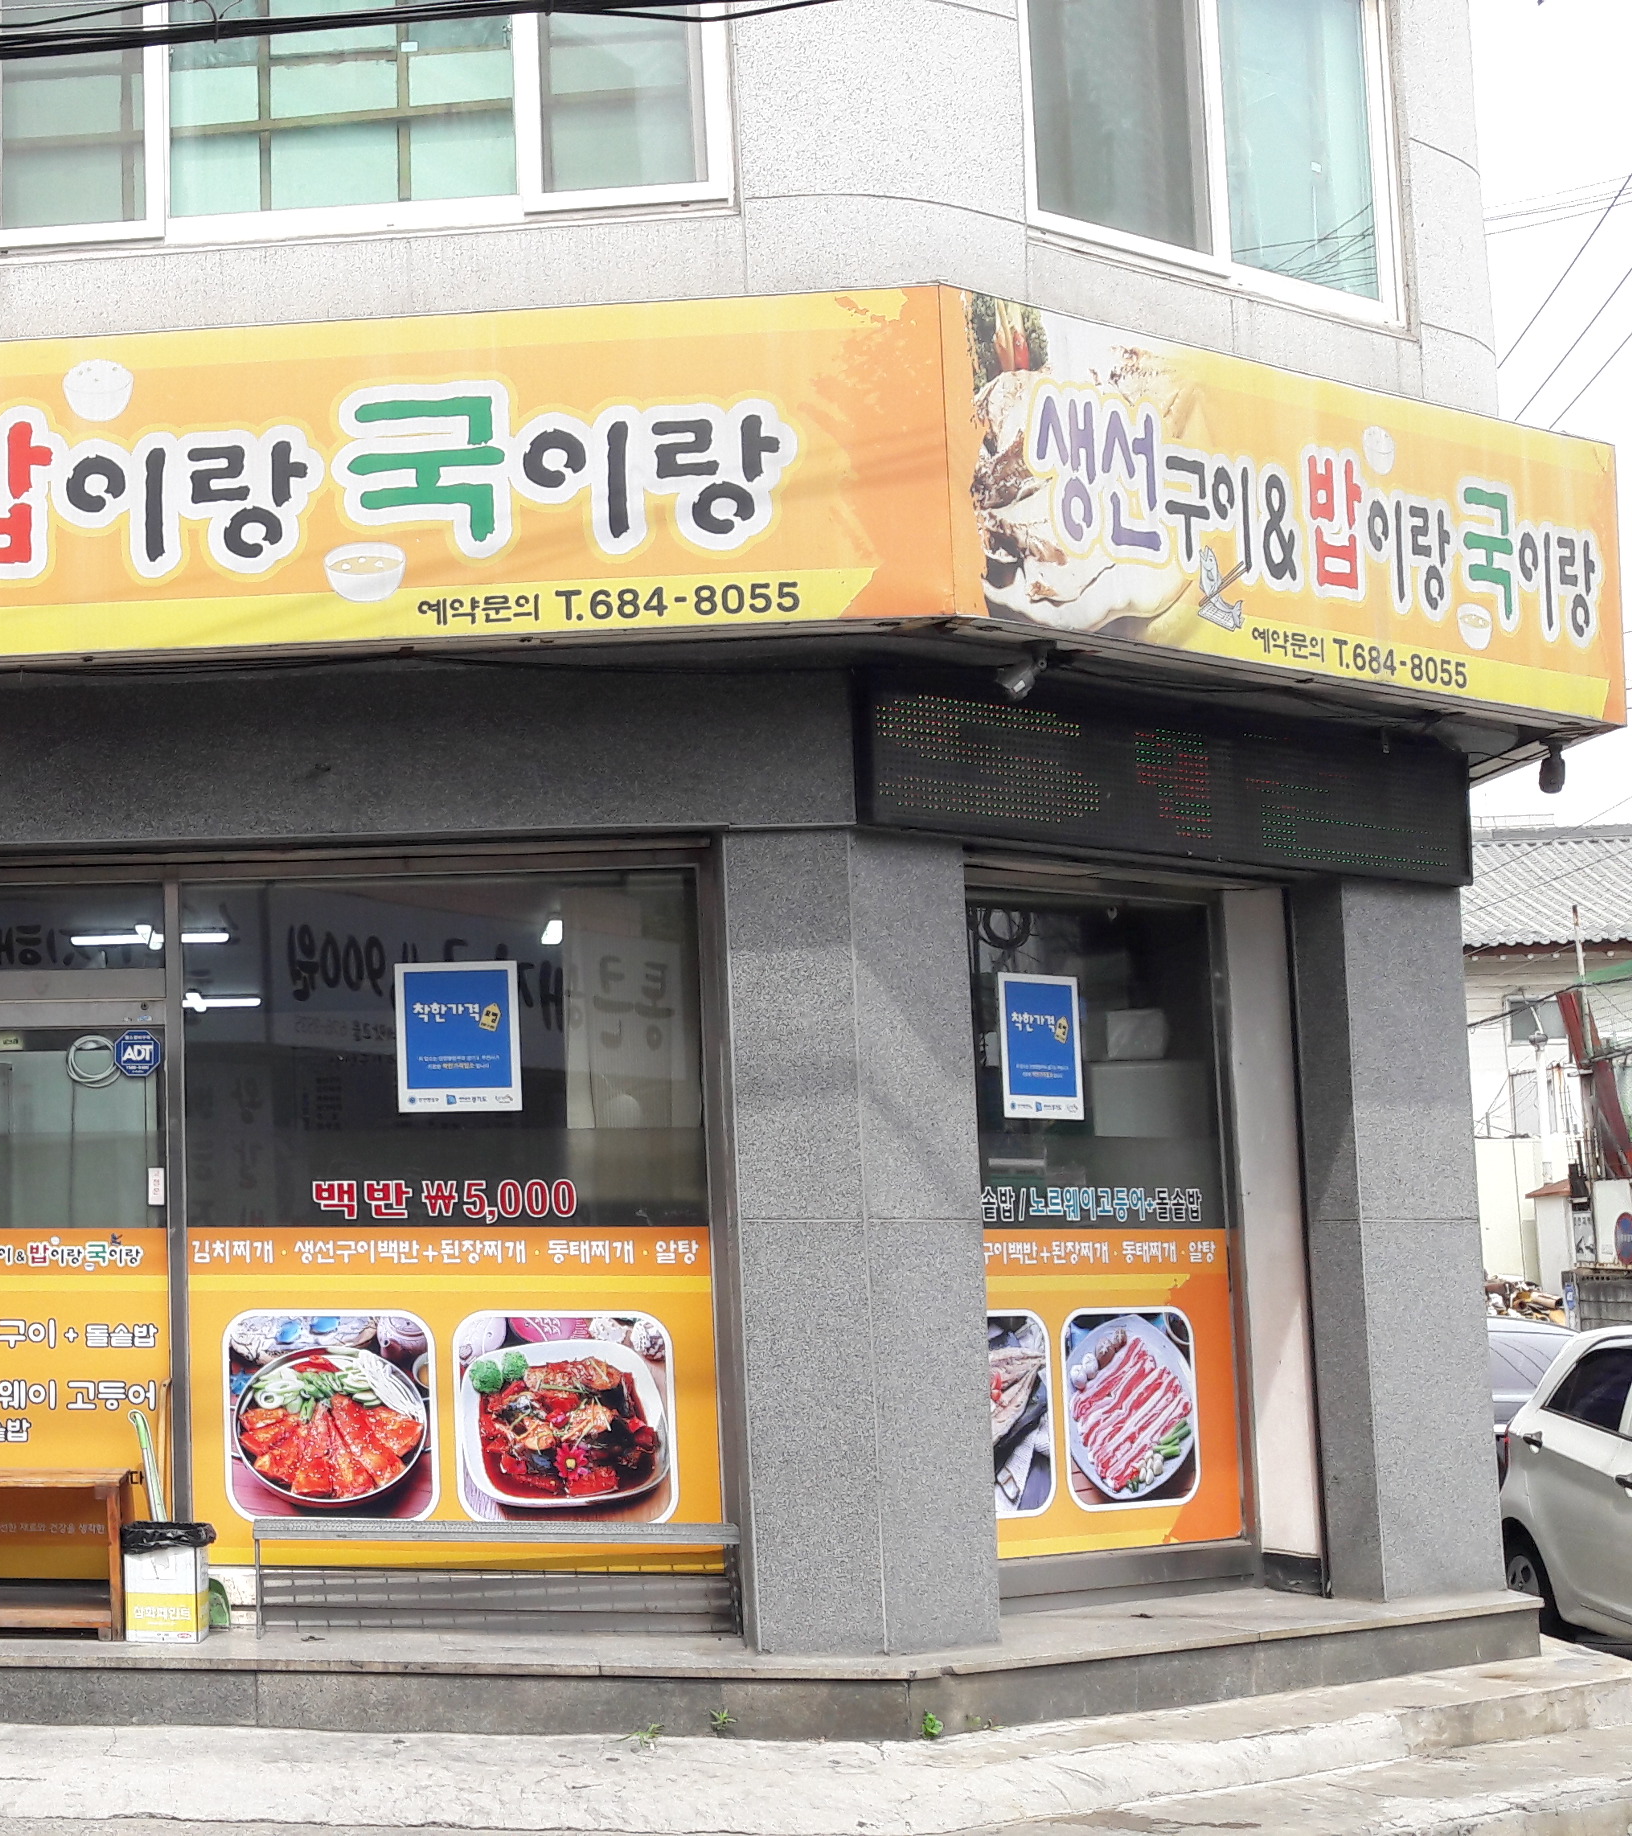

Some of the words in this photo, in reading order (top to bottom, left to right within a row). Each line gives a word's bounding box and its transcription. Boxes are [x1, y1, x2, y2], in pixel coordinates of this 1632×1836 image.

[418, 592, 540, 626] 예약문의
[555, 582, 801, 621] T.684-8055
[1251, 628, 1325, 664] 예약문의
[1333, 637, 1468, 690] T.684-8055
[412, 1002, 480, 1023] 착한가격
[1011, 1011, 1056, 1032] 착한가격
[122, 1044, 153, 1061] ADT
[191, 1239, 275, 1264] 김치찌개
[547, 1239, 635, 1264] 동태찌개
[655, 1239, 700, 1265] 알탕
[1121, 1240, 1177, 1264] 동태찌개
[1188, 1240, 1216, 1263] 알탕
[85, 1324, 159, 1349] 돌솥밥
[66, 1380, 157, 1411] 고등어
